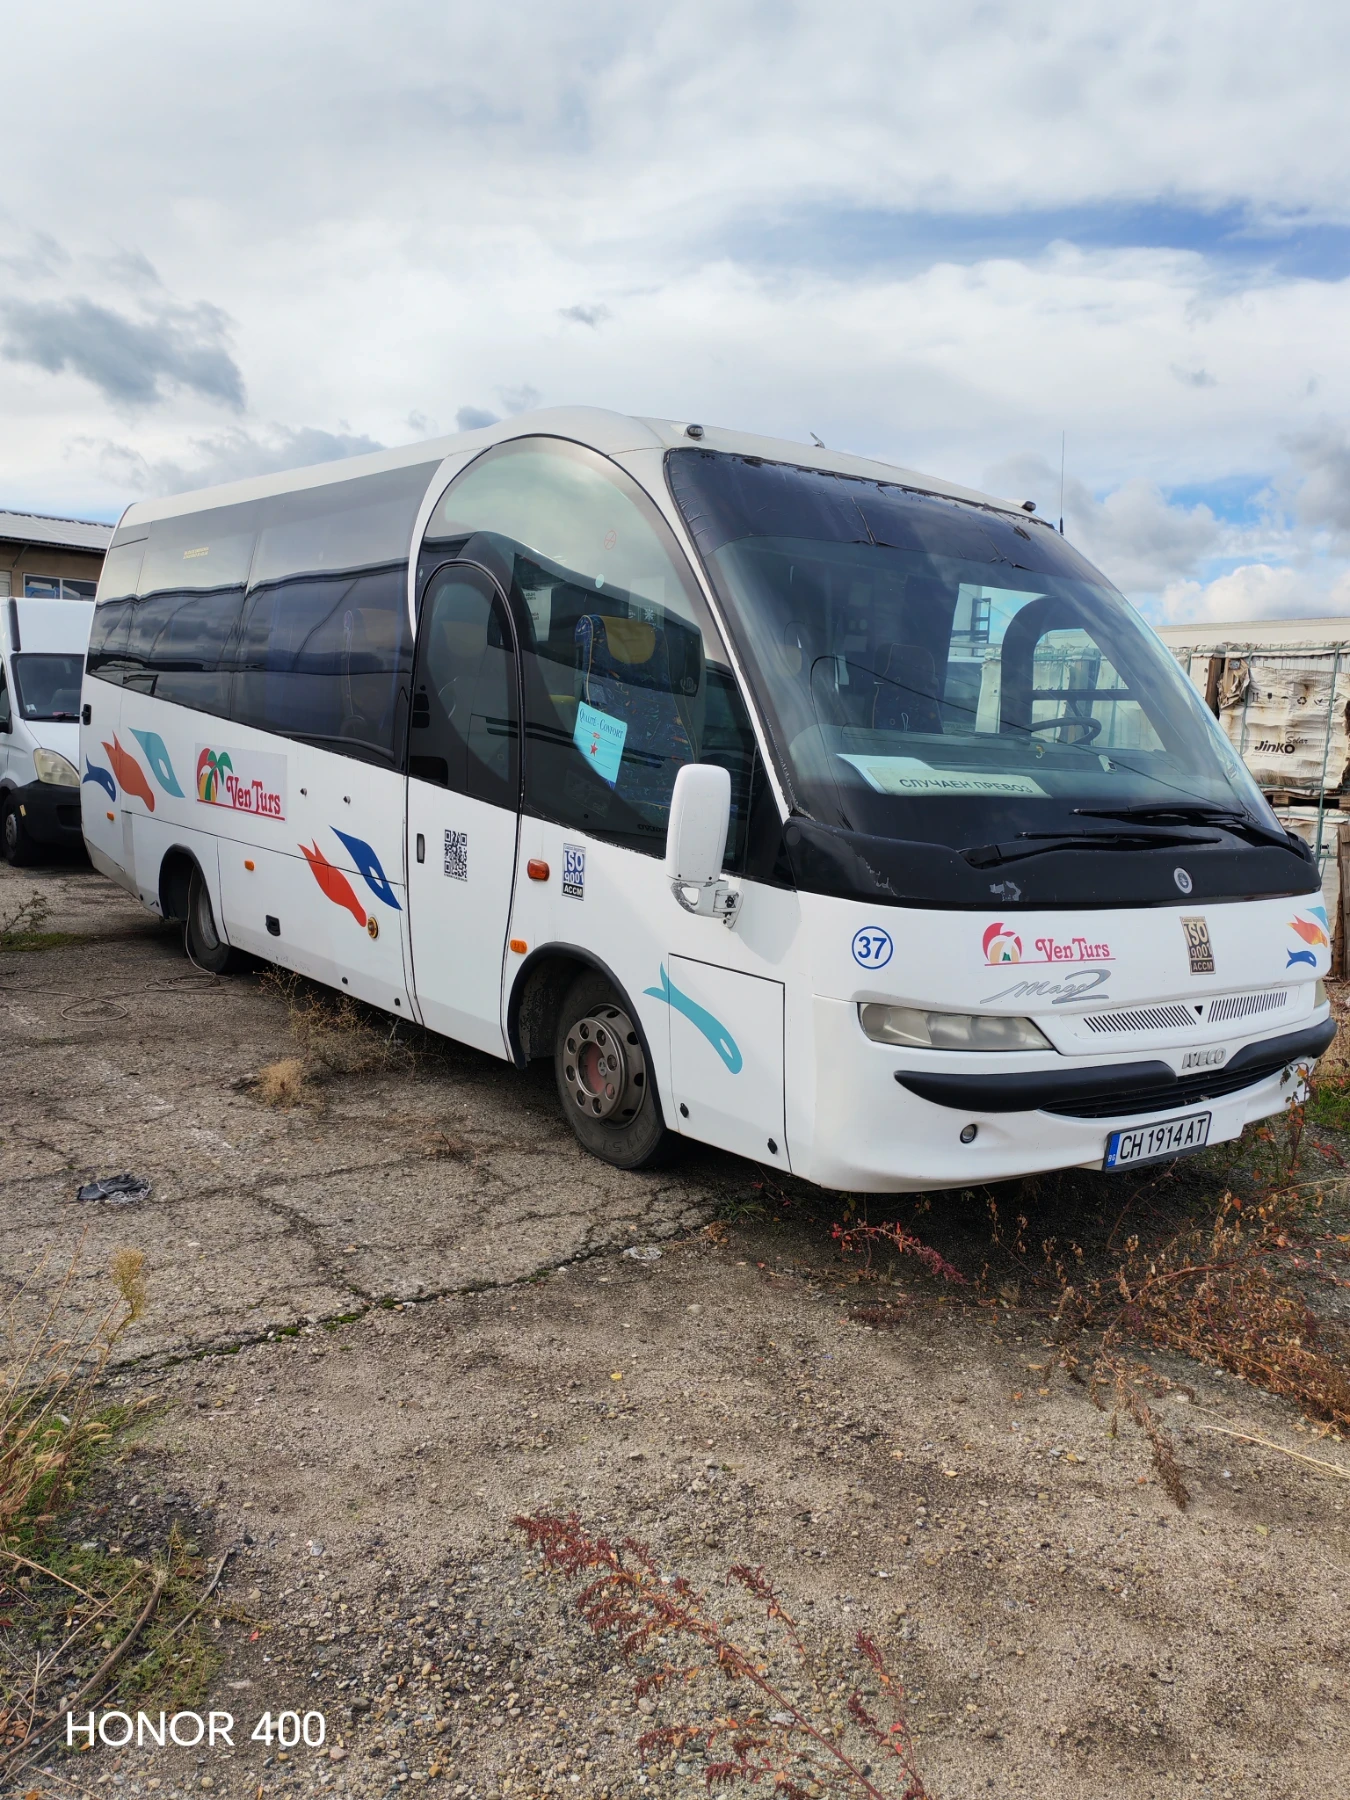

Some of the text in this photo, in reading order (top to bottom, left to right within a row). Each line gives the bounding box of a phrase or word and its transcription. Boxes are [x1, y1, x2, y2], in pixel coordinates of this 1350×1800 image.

[899, 778, 1034, 793] СЛУЧАЕН ПРЕВОЗ
[564, 850, 584, 872] ISO
[564, 872, 584, 884] 9001
[564, 884, 583, 897] ACCM
[1183, 922, 1208, 947] ISO
[858, 936, 887, 959] 37
[1191, 943, 1213, 959] 9001
[1193, 961, 1213, 971] ACCM
[1182, 1048, 1227, 1069] IVECO
[1108, 1153, 1116, 1162] BG
